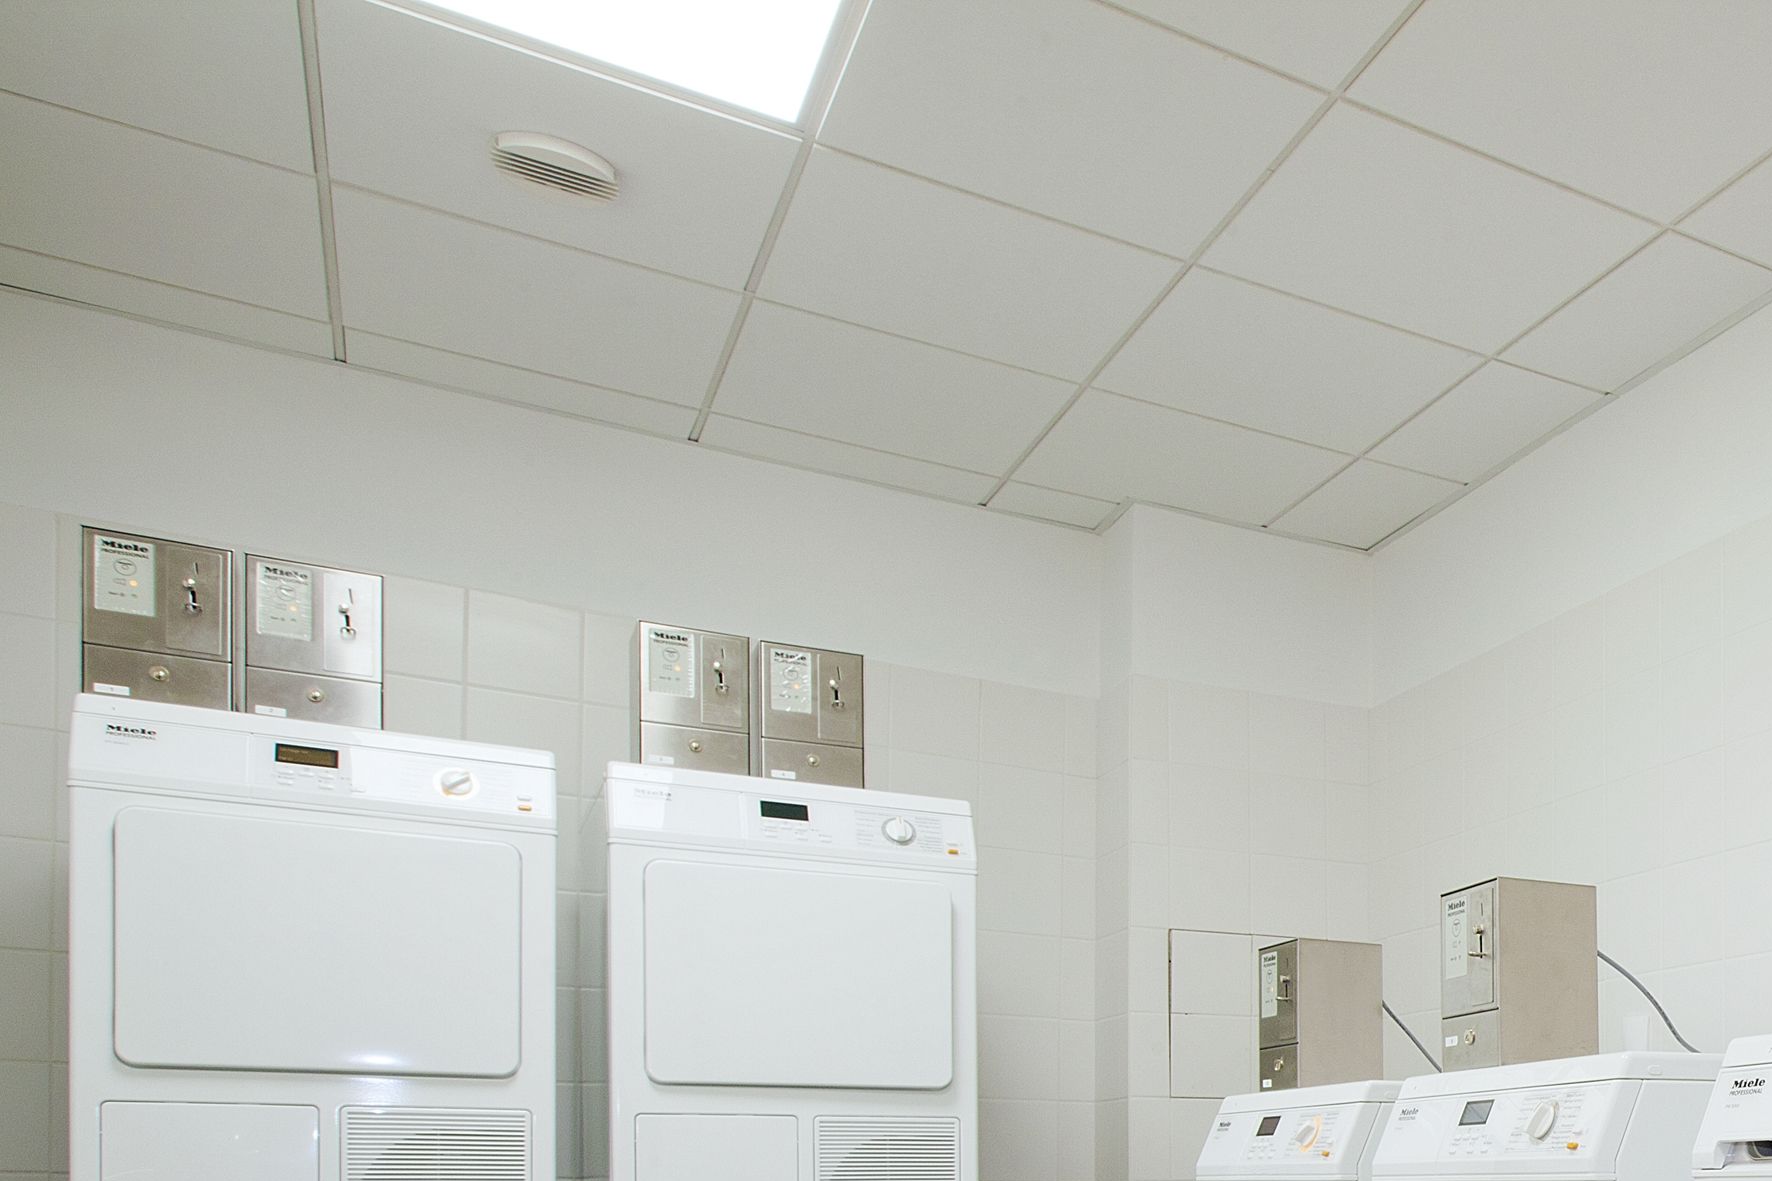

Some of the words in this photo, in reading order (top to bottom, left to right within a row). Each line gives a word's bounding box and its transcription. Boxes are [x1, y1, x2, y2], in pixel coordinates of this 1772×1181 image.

[101, 540, 149, 552] Miele
[654, 632, 688, 641] Miele
[106, 724, 157, 735] Miele
[1732, 1079, 1766, 1089] Miele
